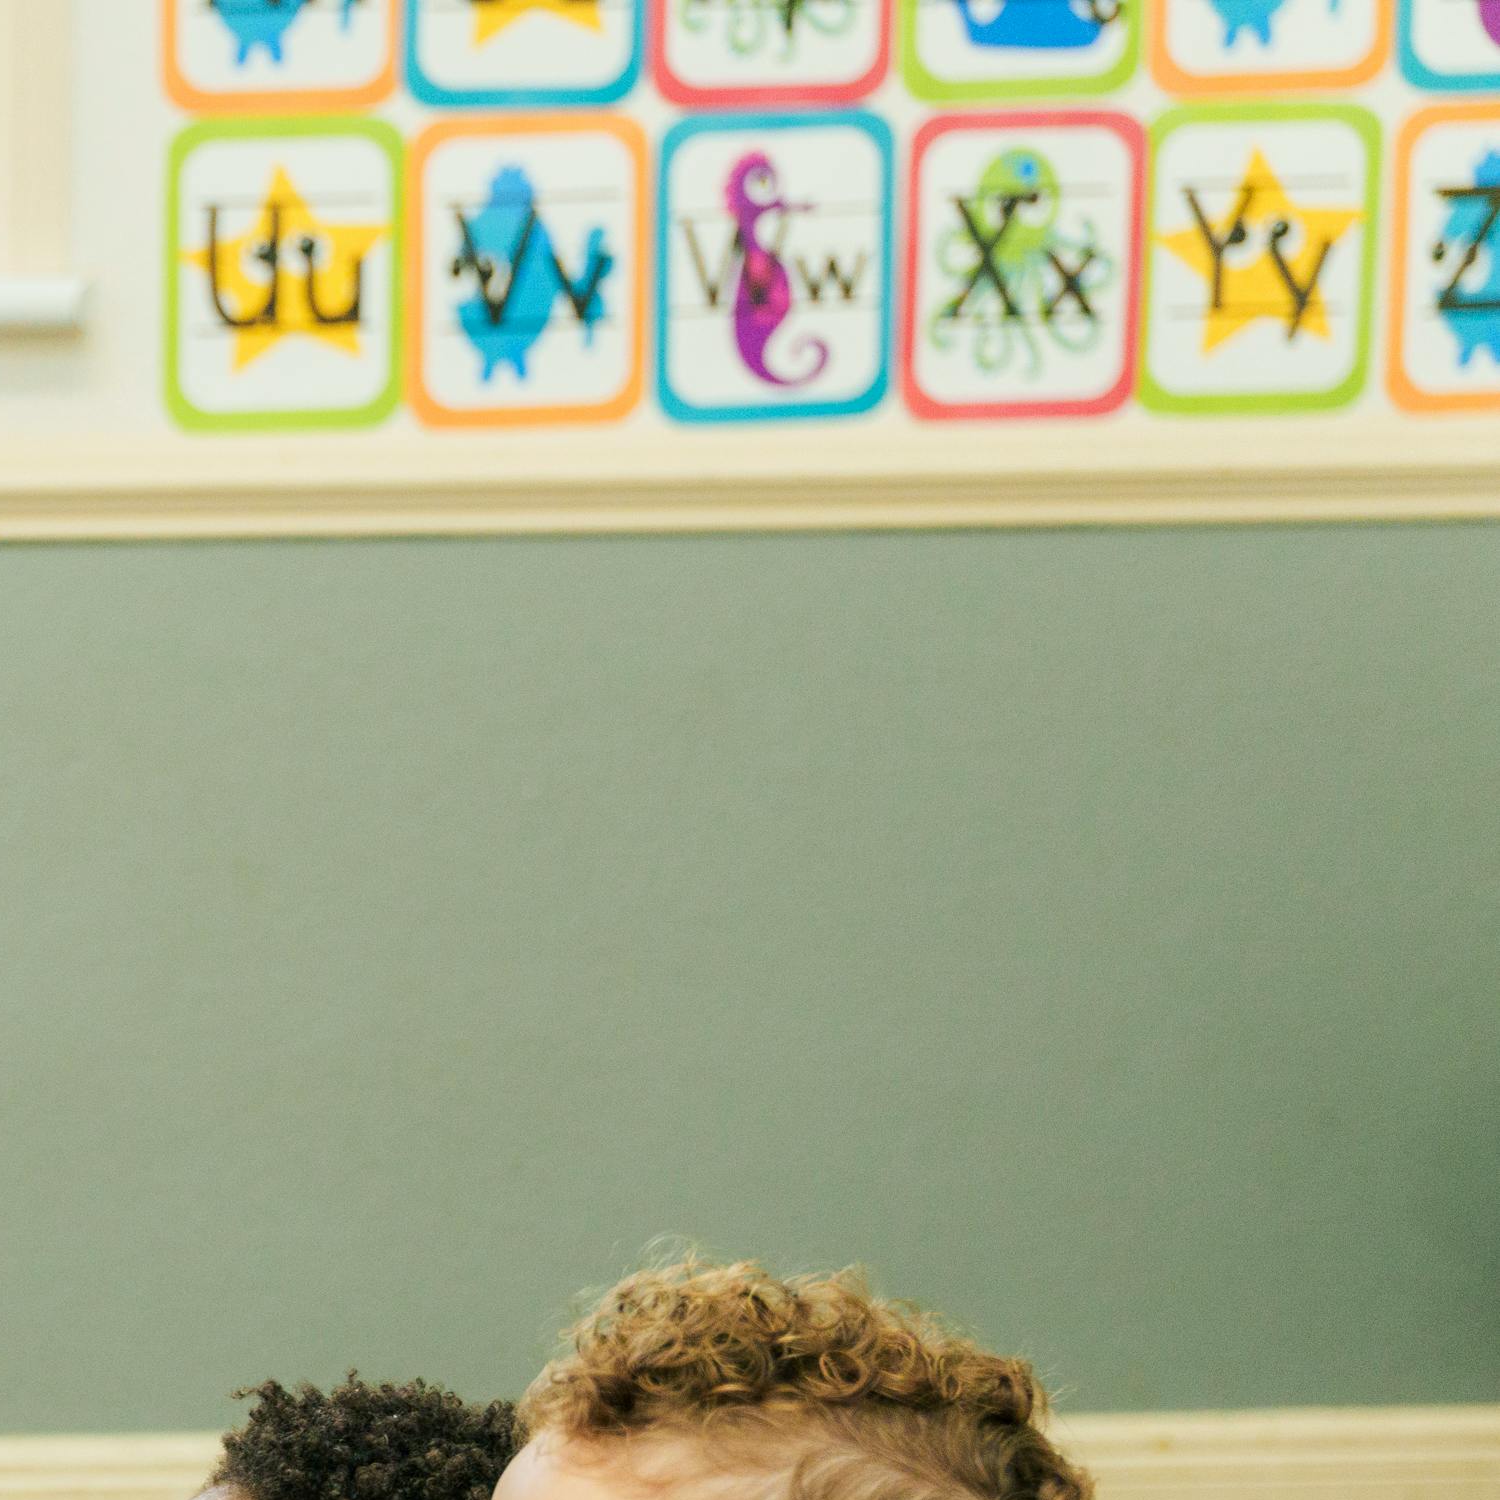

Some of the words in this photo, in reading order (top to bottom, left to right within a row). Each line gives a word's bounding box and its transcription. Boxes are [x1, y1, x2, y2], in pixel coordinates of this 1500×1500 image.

[203, 201, 366, 328] Uu
[452, 200, 610, 325] Vv
[678, 208, 868, 309] Ww
[945, 193, 1099, 319] Xx
[1181, 186, 1333, 339] Yy
